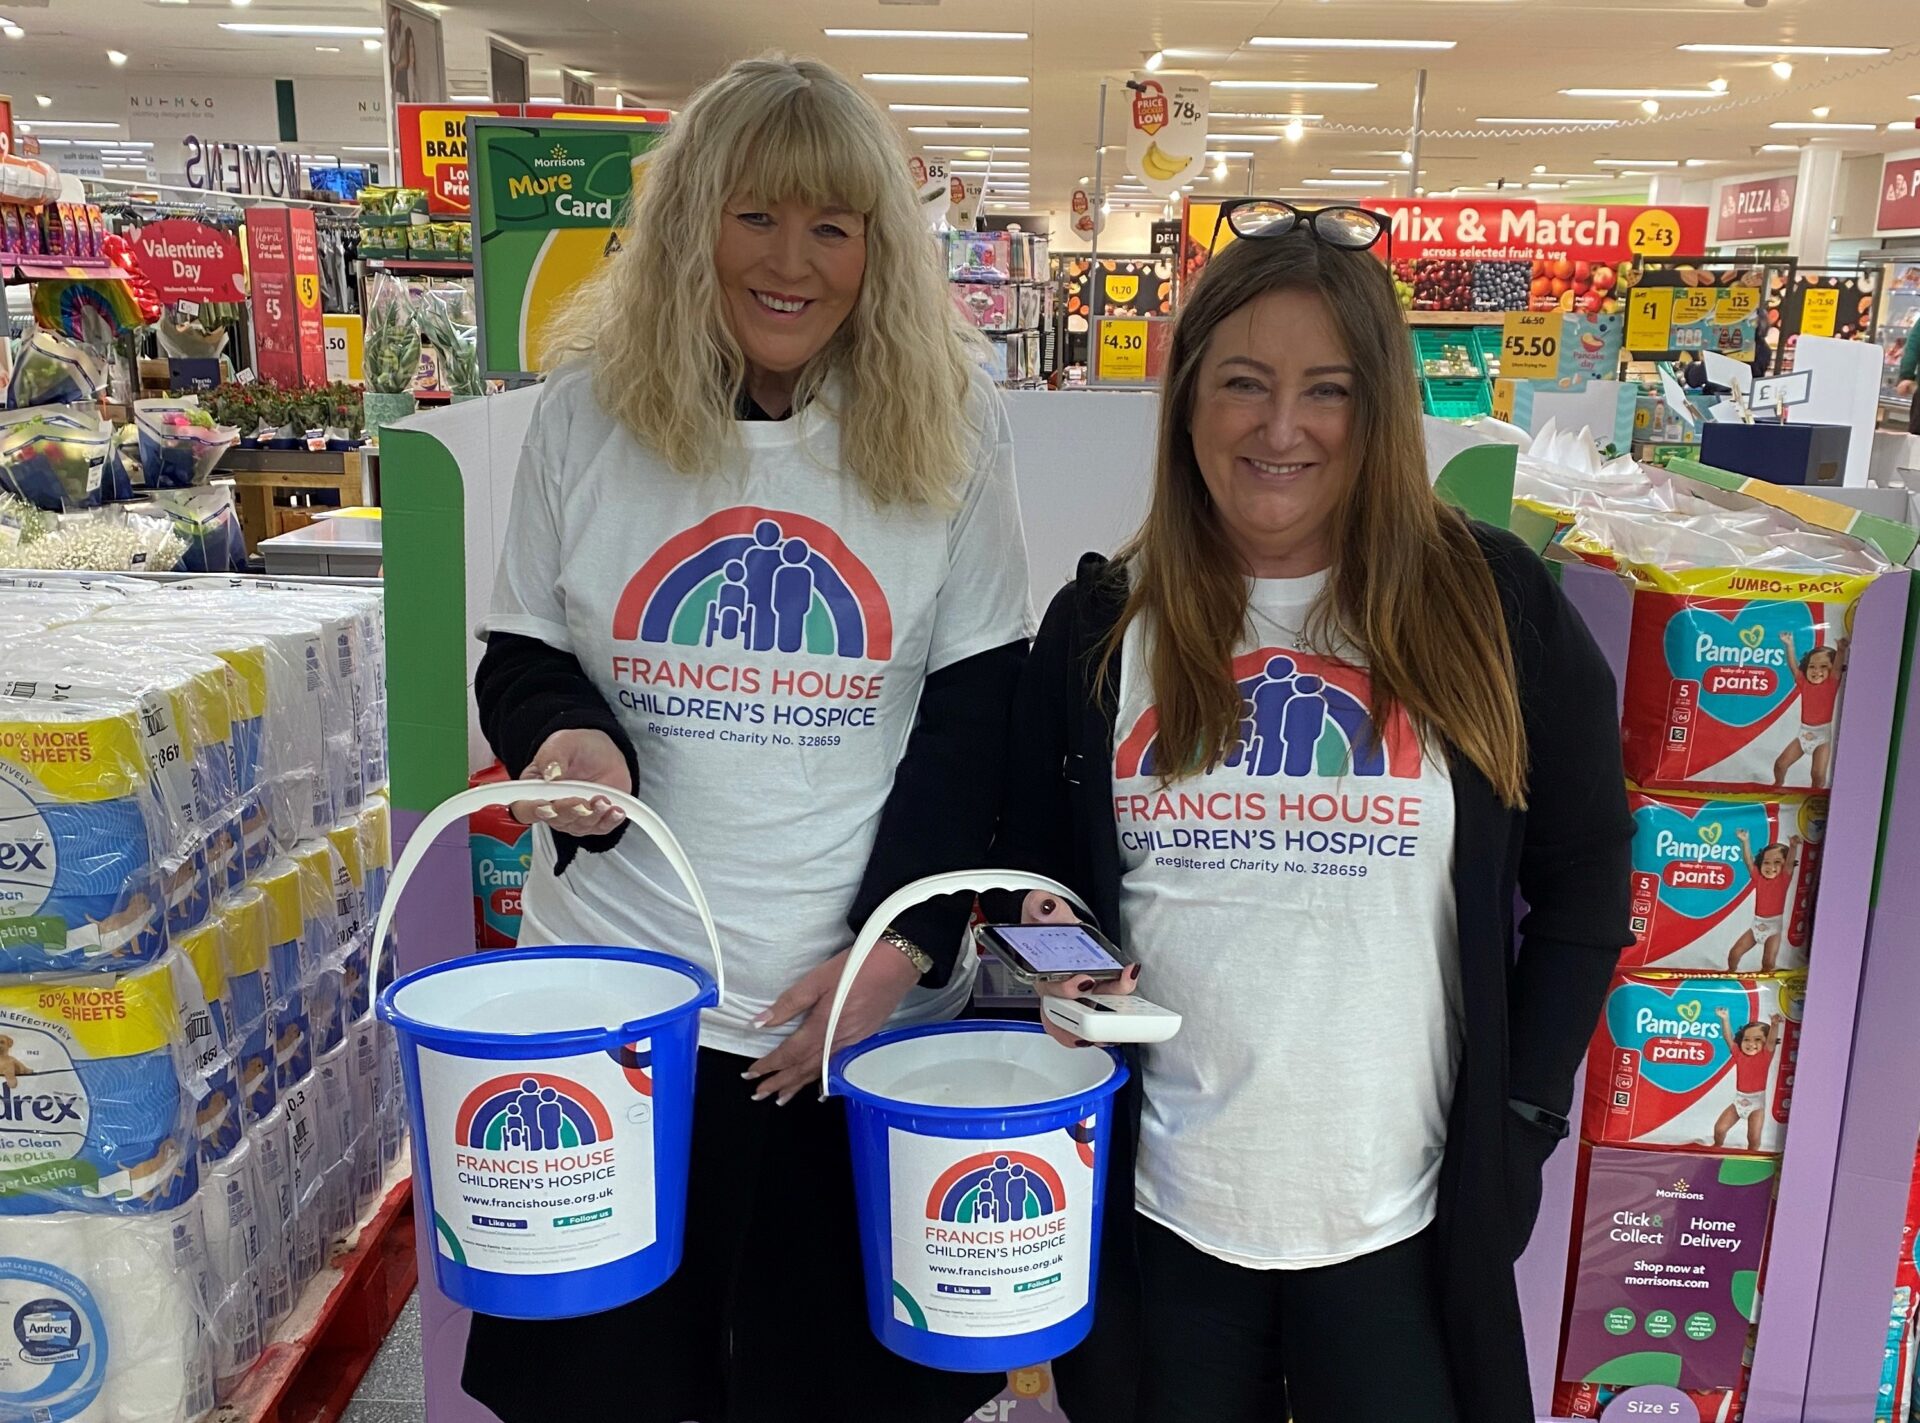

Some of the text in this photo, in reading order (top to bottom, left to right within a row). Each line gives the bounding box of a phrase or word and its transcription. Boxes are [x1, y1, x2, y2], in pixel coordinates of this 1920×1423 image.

[1137, 98, 1163, 108] PRICE
[1173, 101, 1201, 122] 78p
[1138, 113, 1164, 125] LOW
[534, 157, 586, 168] Morrisons
[508, 173, 573, 200] More
[555, 193, 612, 219] Card
[1737, 189, 1771, 215] PIZZA
[1374, 206, 1620, 247] Mix & Match
[1634, 228, 1673, 247] 2 £3
[142, 237, 224, 259] Valentine's
[1422, 246, 1567, 261] across selected fruit & veg
[171, 260, 201, 284] Day
[266, 298, 282, 321] £5
[1689, 296, 1707, 307] 125
[1732, 296, 1749, 308] 125
[1642, 302, 1657, 320] £1
[1103, 335, 1142, 350] £4.30
[1504, 335, 1556, 358] £5.50
[1799, 581, 1844, 594] PACK
[1695, 633, 1786, 668] Pampers
[612, 656, 885, 700] FRANCIS HOUSE
[1712, 676, 1769, 692] pants
[1680, 685, 1689, 697] 5
[618, 690, 877, 728] CHILDREN'S HOSPICE
[0, 731, 90, 748] 0% MORE
[647, 721, 841, 747] Registered Charity No. 328659
[20, 748, 92, 763] SHEETS
[1113, 791, 1423, 827] FRANCIS HOUSE
[1121, 828, 1418, 857] CHILDREN'S HOSPICE
[1656, 830, 1741, 863] Pampers
[1155, 856, 1368, 877] Registered Charity No. 328659
[1639, 877, 1650, 889] 5
[1672, 869, 1726, 886] pants
[38, 989, 126, 1010] 50% MORE
[62, 1005, 127, 1022] SHEETS
[10, 1012, 72, 1042] EFFECTIVELY
[1636, 1007, 1720, 1040] Pampers
[1621, 1053, 1631, 1065] 5
[1652, 1045, 1706, 1062] pants
[18, 1138, 62, 1149] Clean
[13, 1151, 56, 1163] ROLLS
[455, 1147, 616, 1175] FRANCIS HOUSE
[21, 1167, 77, 1187] Lasting
[457, 1165, 616, 1190] CHILDREN'S HOSPICE
[463, 1188, 614, 1209] www.francishouse.org.uk
[1655, 1188, 1705, 1201] Morrisons
[488, 1219, 506, 1228] Like
[569, 1210, 609, 1225] Follow us
[1613, 1211, 1664, 1228] Click &
[1690, 1216, 1736, 1233] Home
[925, 1217, 1067, 1245] FRANCIS HOUSE
[1609, 1228, 1664, 1245] Collect
[925, 1233, 1067, 1259] CHILDREN'S HOSPICE
[1680, 1232, 1742, 1252] Delivery
[929, 1256, 1064, 1276] www.francishouse.org.uk
[1633, 1260, 1706, 1275] Shop now at
[953, 1286, 970, 1294] Like
[1027, 1278, 1050, 1290] Follow
[1625, 1274, 1709, 1289] morrisons.com
[29, 1323, 68, 1335] Andrex
[1627, 1399, 1680, 1414] Size 5
